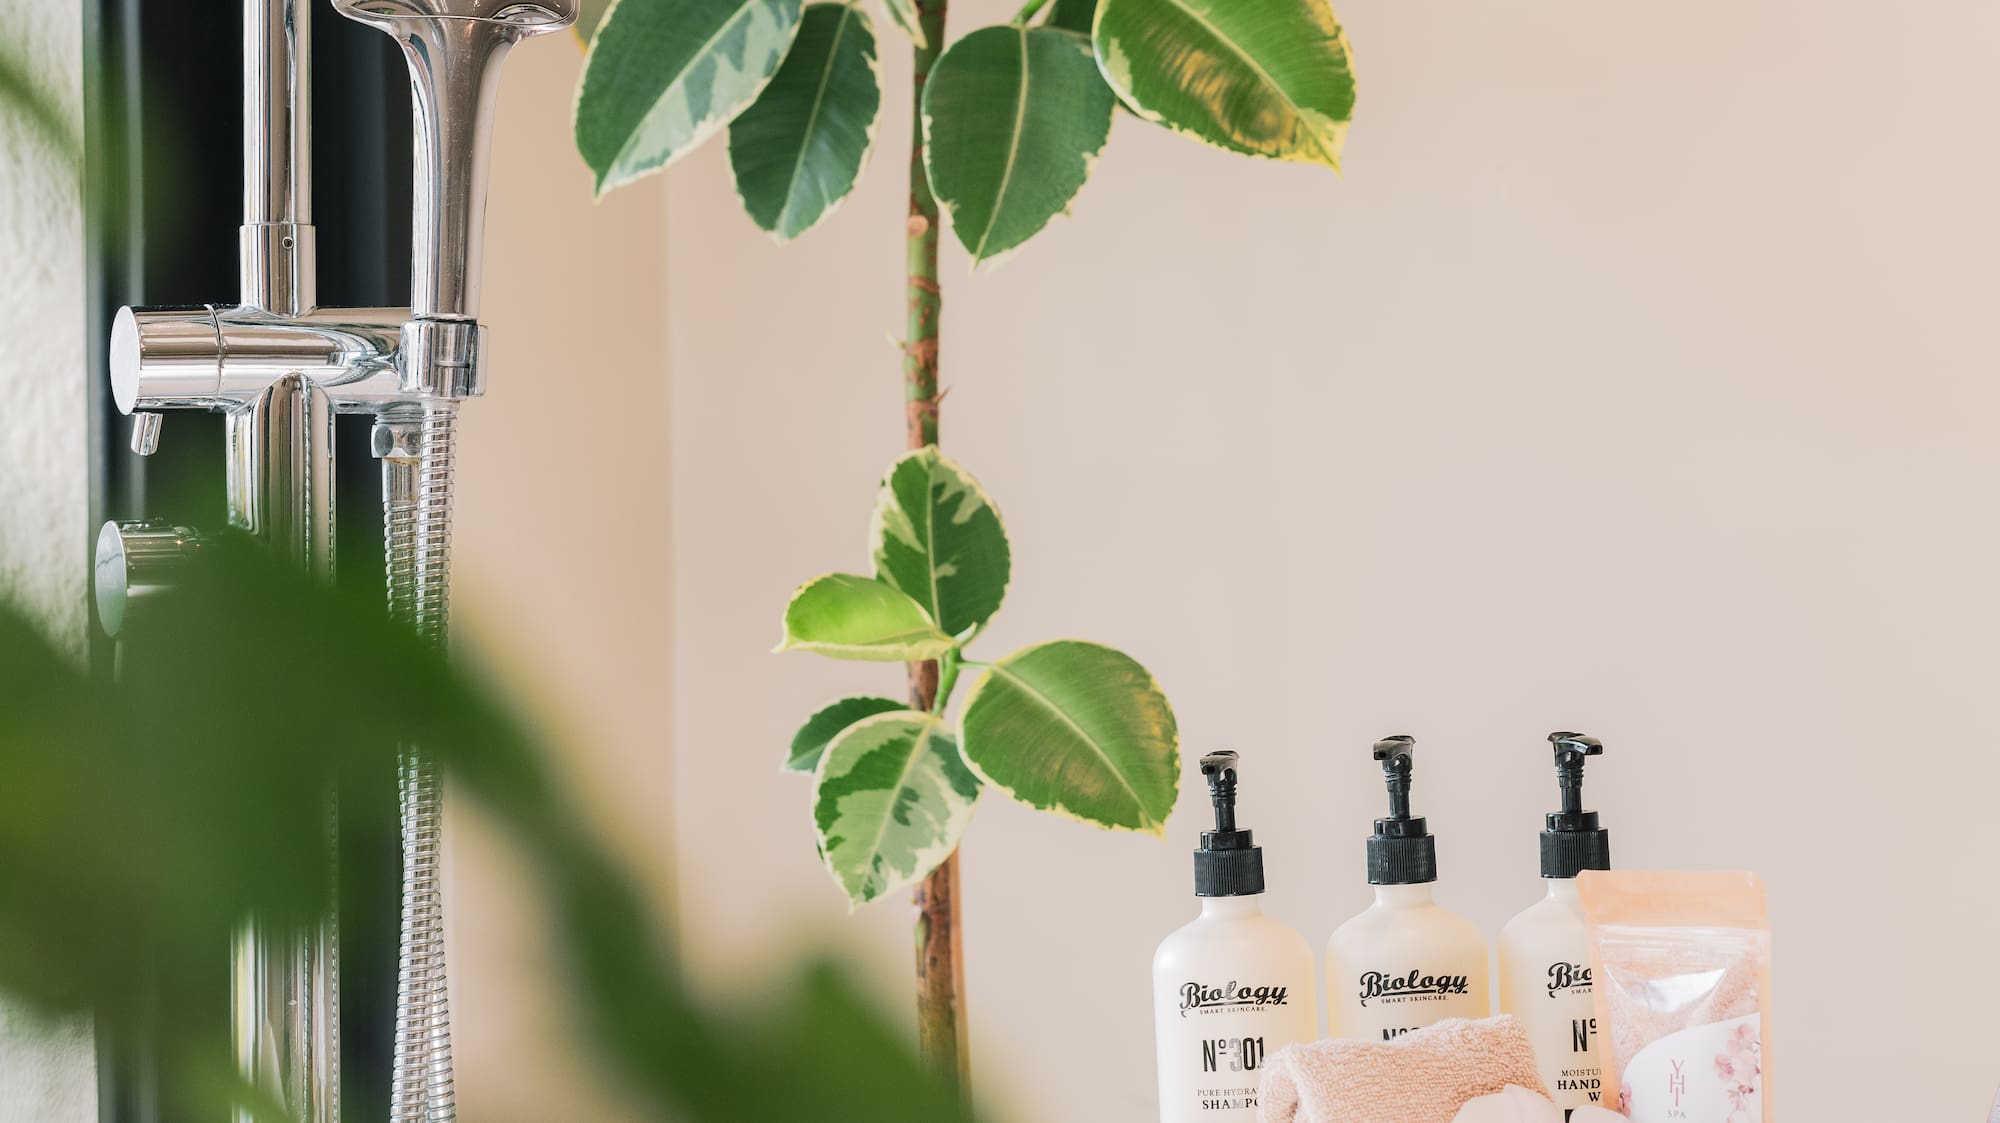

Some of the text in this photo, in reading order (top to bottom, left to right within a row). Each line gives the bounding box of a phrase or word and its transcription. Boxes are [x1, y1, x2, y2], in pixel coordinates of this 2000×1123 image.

[1360, 969, 1468, 1008] Biology
[1179, 980, 1288, 1018] Biology
[1561, 1068, 1601, 1077] MOISTU
[1557, 1078, 1601, 1090] HAND
[1197, 1088, 1221, 1097] PURE
[1667, 1109, 1687, 1120] SPA
